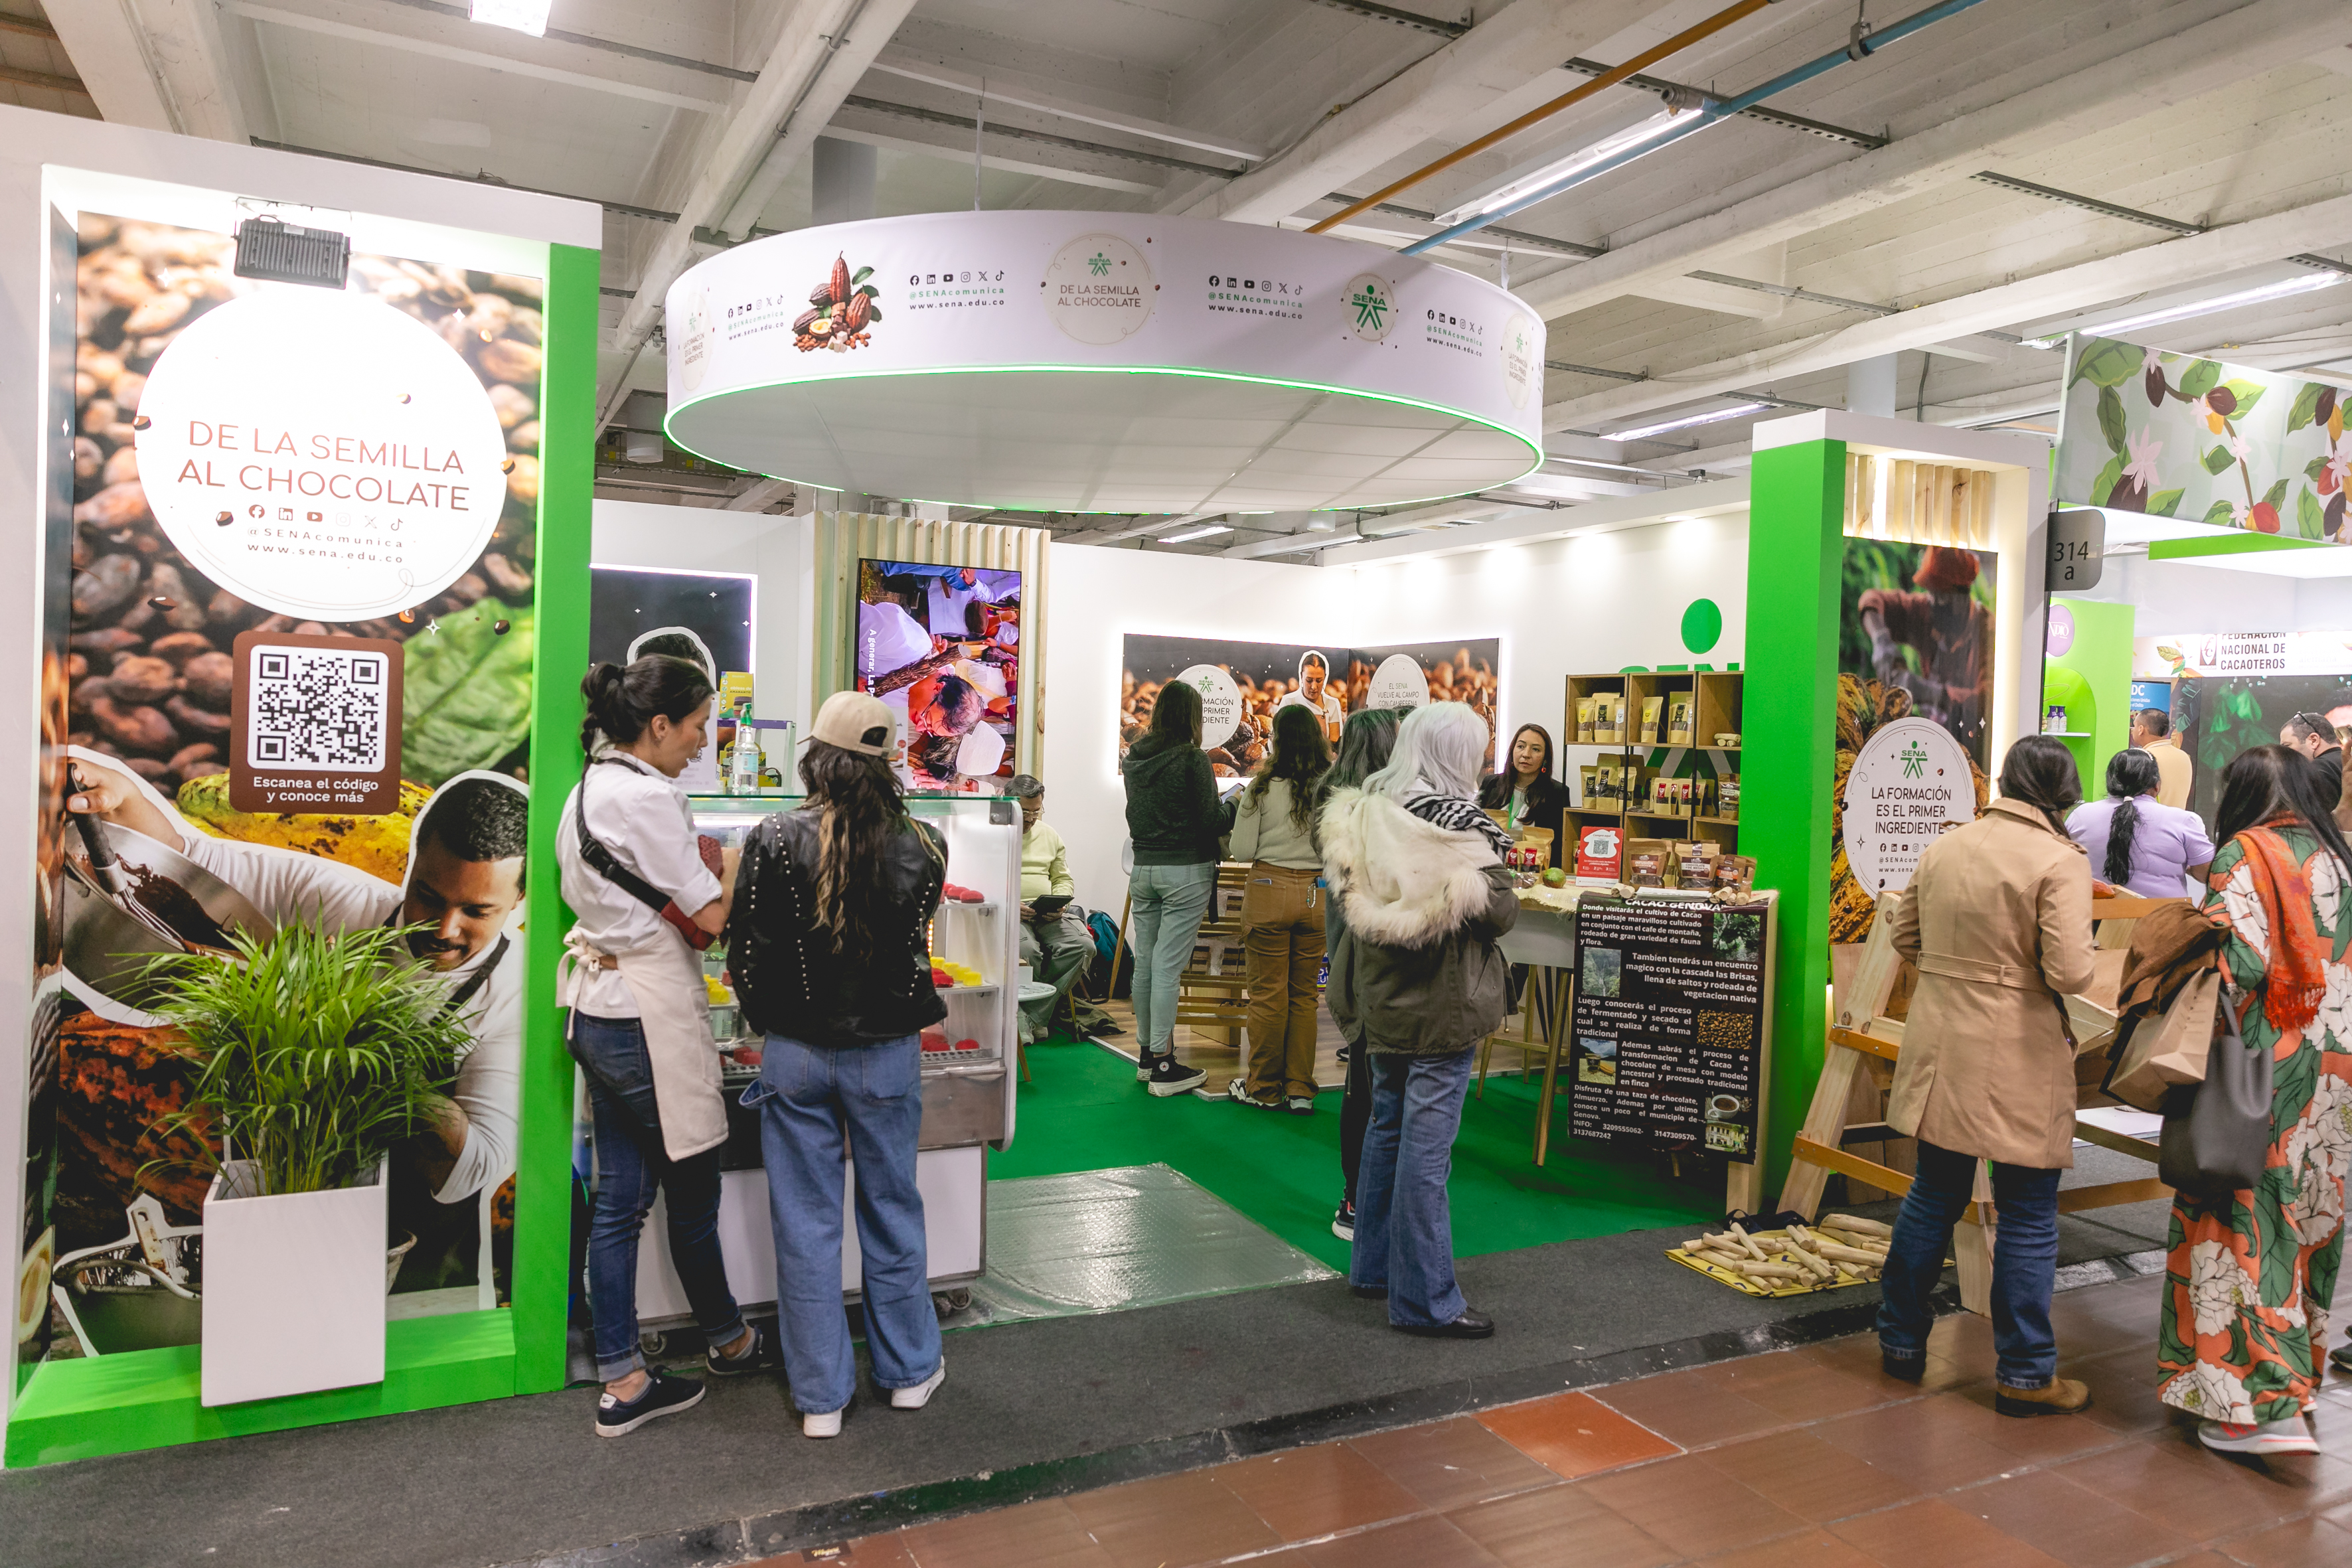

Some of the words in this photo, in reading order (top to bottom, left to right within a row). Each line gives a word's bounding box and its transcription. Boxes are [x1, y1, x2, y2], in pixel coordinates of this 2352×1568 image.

[909, 286, 1005, 299] @SENAcomunica
[1061, 285, 1075, 294] DE
[1078, 285, 1091, 294] LA
[1094, 285, 1139, 295] SEMILLA
[909, 299, 1004, 309] www.sena.edu.co
[1058, 297, 1071, 306] AL
[1074, 297, 1141, 307] CHOCOLATE
[1208, 291, 1304, 308] @SENAcomunica
[1352, 292, 1386, 307] SENA
[1208, 302, 1302, 319] www.sena.edu.co
[1427, 325, 1482, 347] @SENAcomunica
[1427, 337, 1482, 356] www.sena.edu.co
[189, 420, 239, 449] DE
[254, 428, 298, 456] LA
[310, 435, 465, 474] SEMILLA
[177, 458, 226, 488] AL
[239, 464, 470, 511] CHOCOLATE
[248, 526, 404, 549] @SENAcomunica
[248, 542, 404, 564] www.sena.edu.co
[2053, 540, 2088, 562] 314
[2065, 566, 2074, 580] a
[867, 637, 876, 673] generar,
[2222, 644, 2269, 655] NACIONAL
[2274, 643, 2285, 653] DE
[2221, 659, 2285, 670] CACAOTEROS
[868, 674, 875, 686] La
[2131, 684, 2145, 696] DC
[254, 777, 312, 788] Escanea
[317, 778, 330, 789] el
[333, 778, 378, 793] código
[267, 792, 275, 803] y
[279, 792, 330, 802] conoce
[335, 791, 364, 803] más
[1871, 787, 1885, 799] LA
[1887, 785, 1951, 801] FORMACIÓN
[1877, 805, 1889, 817] ES
[1893, 805, 1905, 817] EL
[1909, 805, 1945, 817] PRIMER
[1875, 822, 1944, 834] INGREDIENTE
[1625, 898, 1666, 907] CACAO
[1632, 953, 1667, 962] Tambien
[1669, 957, 1700, 965] tendrás
[1715, 961, 1758, 970] encuentro
[1626, 964, 1654, 973] magico
[1730, 972, 1757, 982] Brisas,
[1644, 975, 1664, 983] llena
[1711, 982, 1745, 991] rodeada
[1684, 990, 1728, 1000] vegetacion
[1574, 1093, 1608, 1103] Almuerzo.
[1616, 1099, 1644, 1107] Ademas
[1575, 1085, 1601, 1093] Disfruta
[1662, 1095, 1697, 1105] chocolate,
[1574, 1111, 1601, 1120] Genova.
[1650, 1113, 1684, 1122] municipio
[1573, 1128, 1611, 1139] 3137687242
[1603, 1123, 1644, 1134] 3209555062-
[1654, 1131, 1697, 1140] 3147309570-
